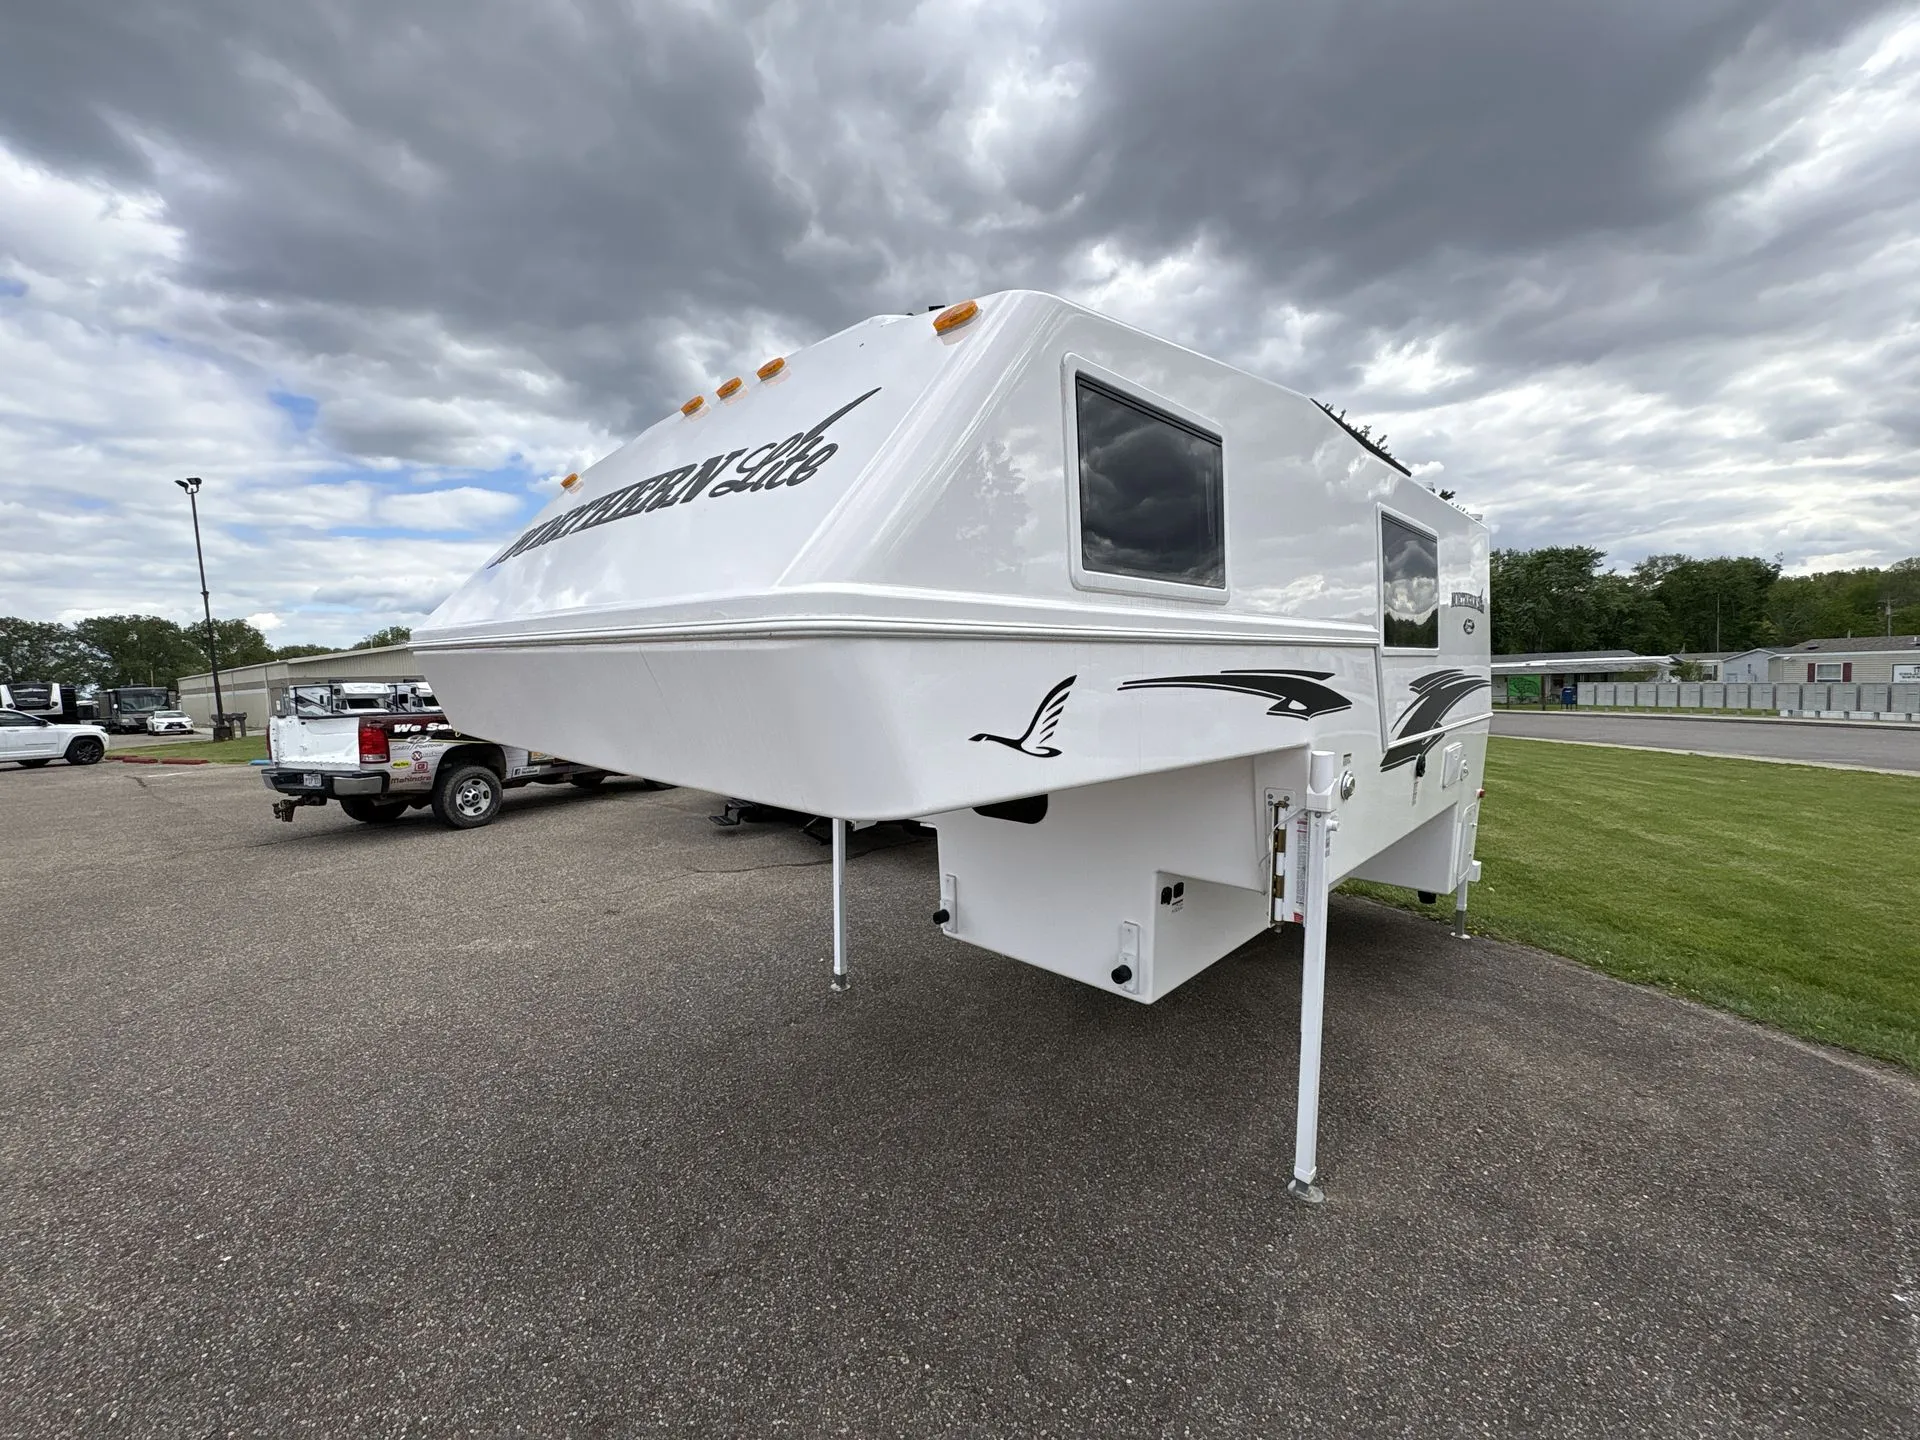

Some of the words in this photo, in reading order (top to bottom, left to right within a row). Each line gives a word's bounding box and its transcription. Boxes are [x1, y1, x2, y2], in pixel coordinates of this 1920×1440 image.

[487, 447, 748, 569] NORTHERN
[394, 723, 422, 733] We
[390, 775, 432, 784] Mahindra
